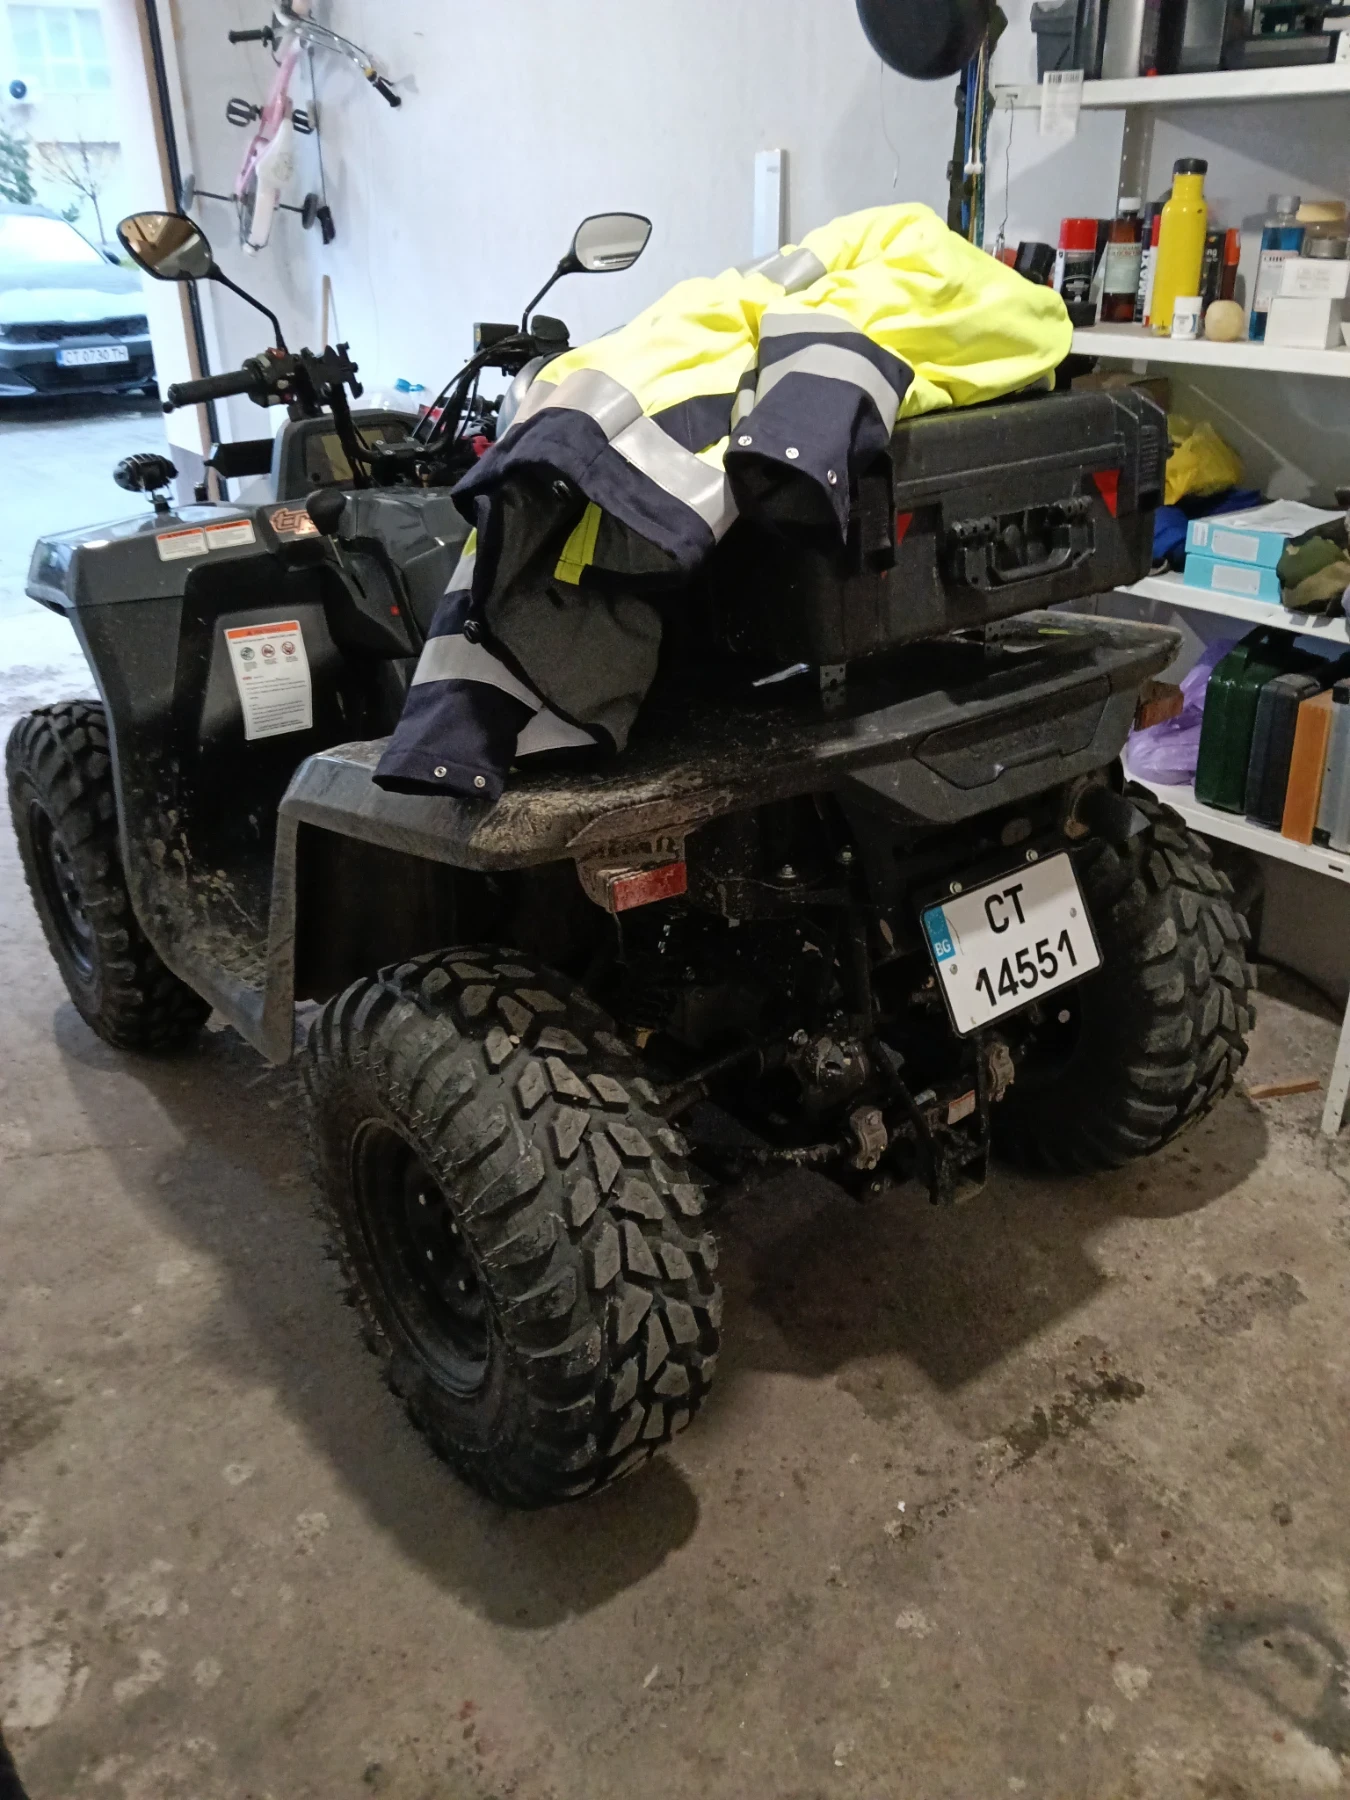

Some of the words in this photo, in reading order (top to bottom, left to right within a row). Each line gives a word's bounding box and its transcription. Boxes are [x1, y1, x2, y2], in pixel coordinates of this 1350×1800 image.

[67, 350, 79, 363] CT
[984, 883, 1026, 934] CT
[934, 939, 952, 956] BG
[975, 929, 1077, 1007] 14551
